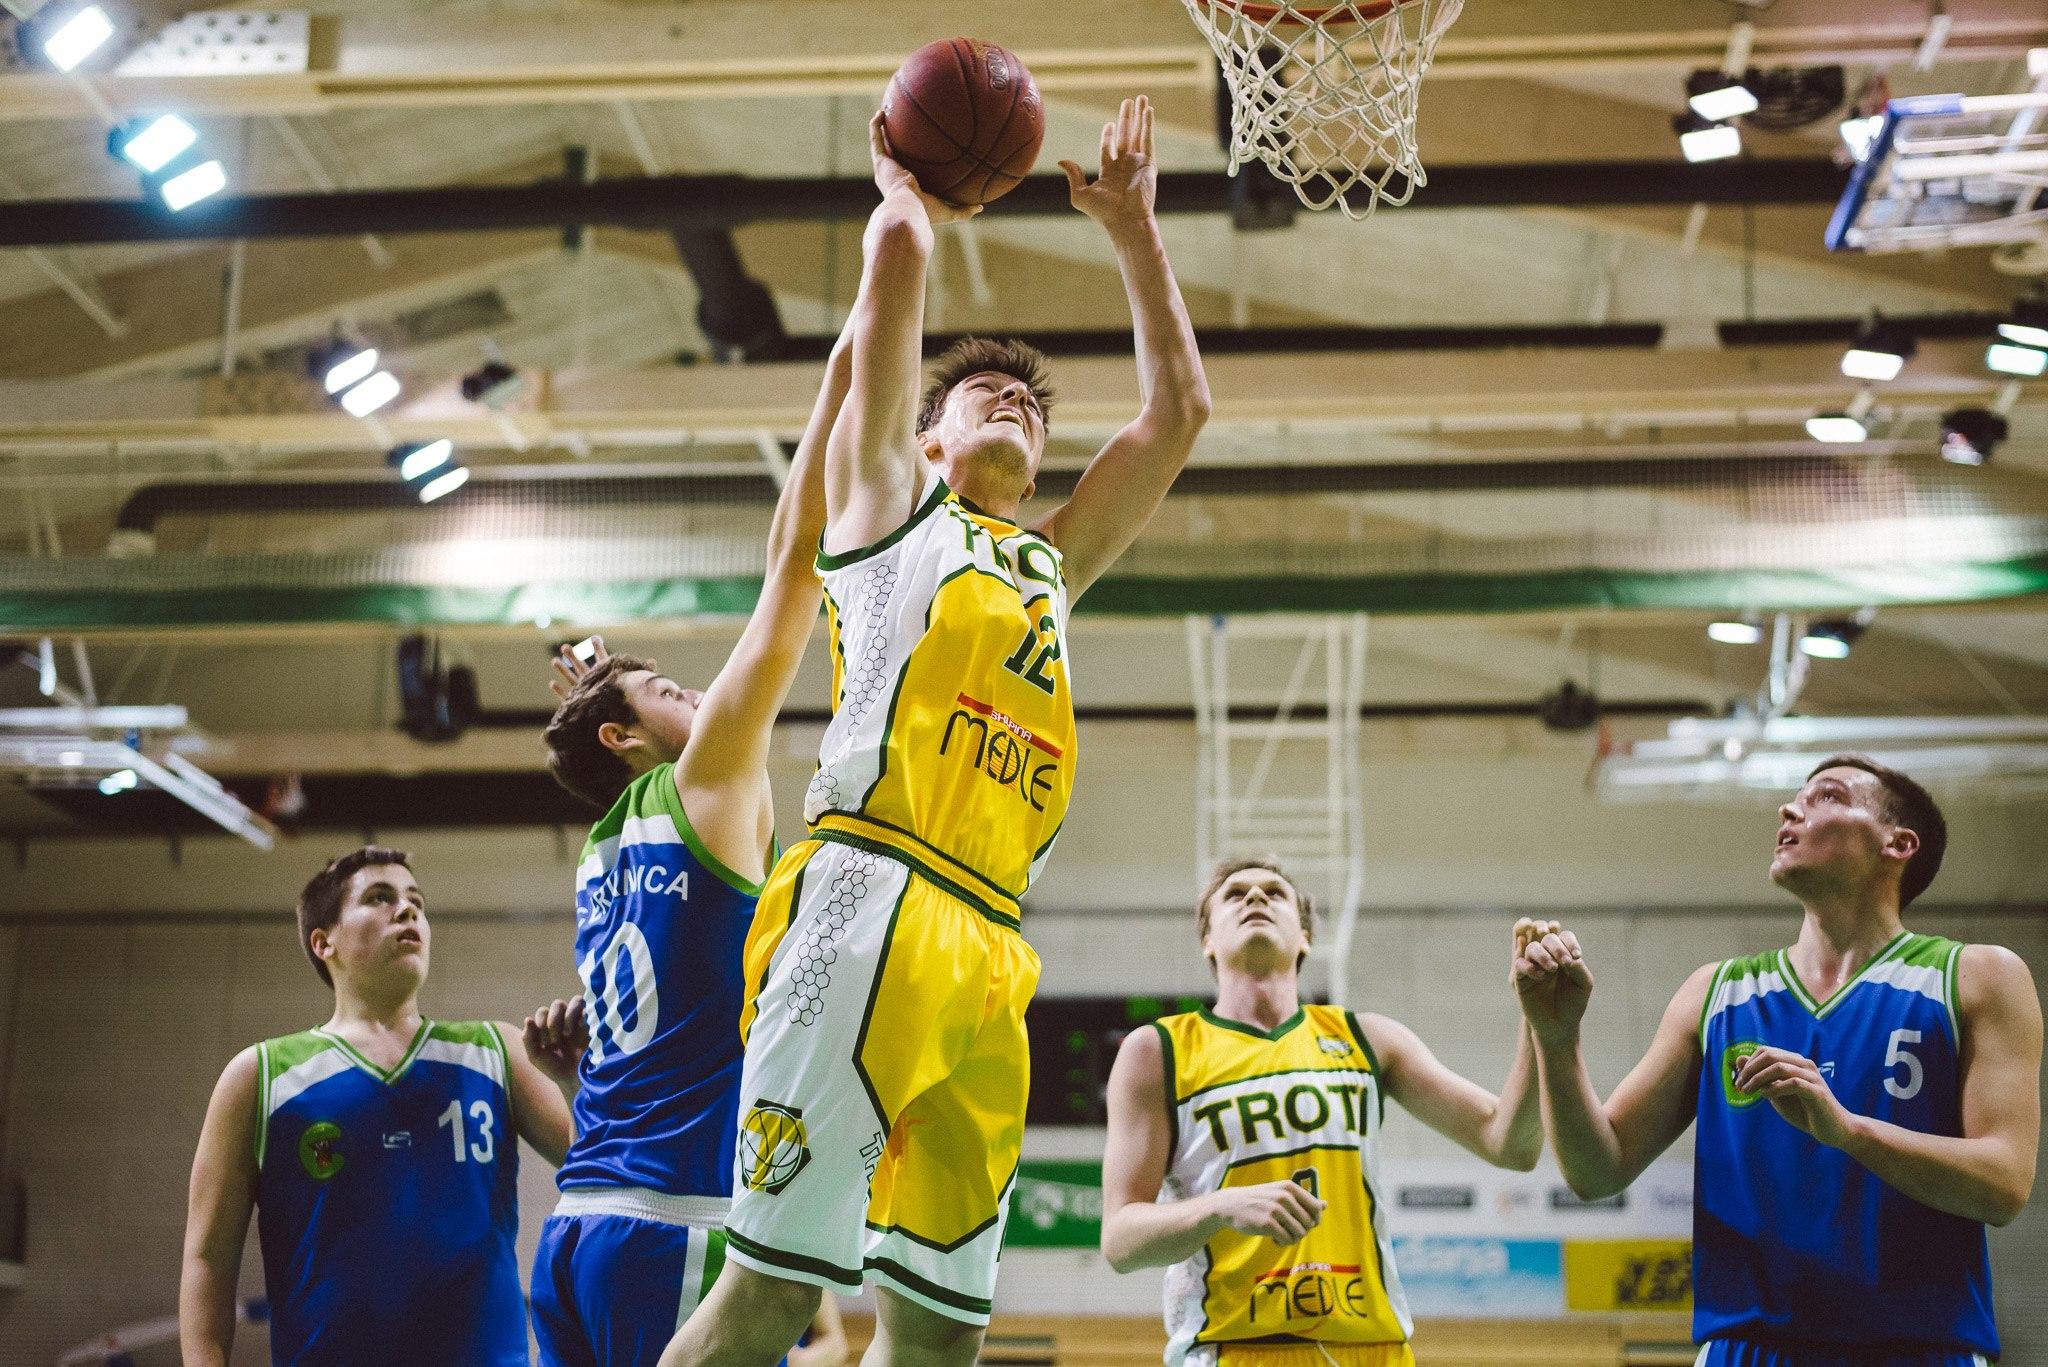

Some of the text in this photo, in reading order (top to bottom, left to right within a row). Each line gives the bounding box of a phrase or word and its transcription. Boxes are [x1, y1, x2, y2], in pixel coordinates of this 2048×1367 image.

[1003, 614, 1061, 696] 12
[578, 921, 659, 1066] 10
[1883, 1028, 1924, 1101] 5
[438, 1099, 494, 1164] 13
